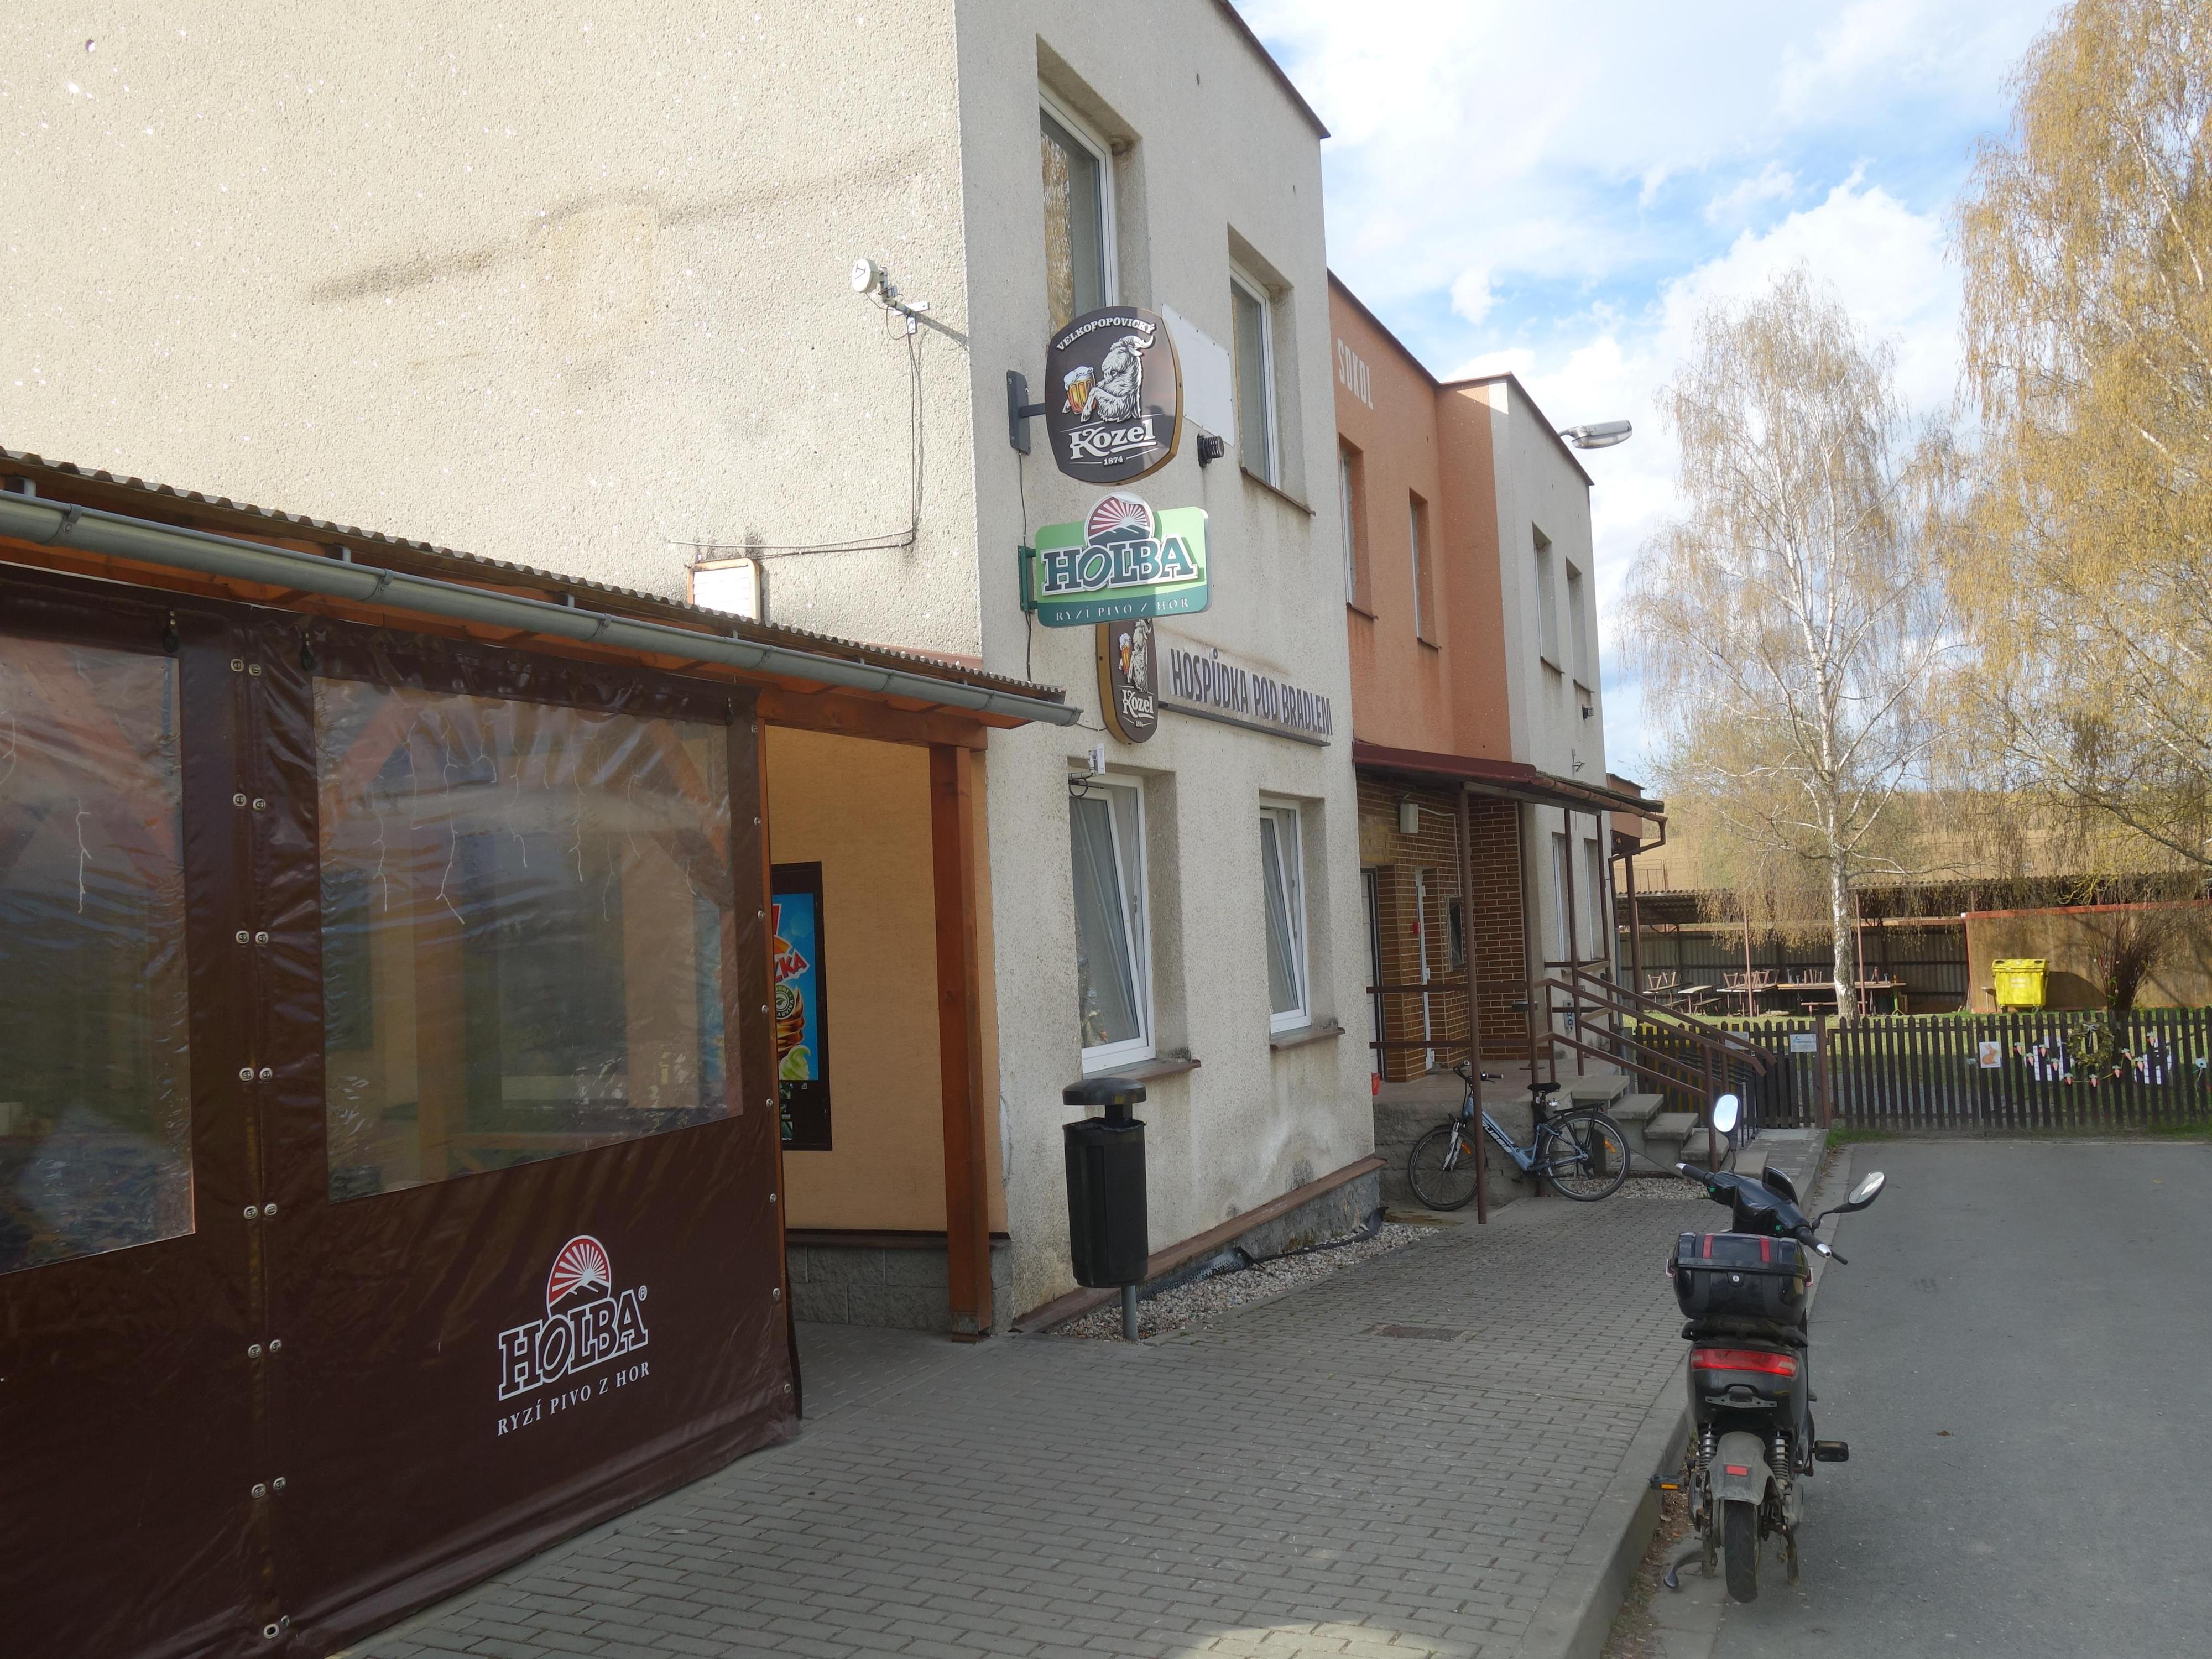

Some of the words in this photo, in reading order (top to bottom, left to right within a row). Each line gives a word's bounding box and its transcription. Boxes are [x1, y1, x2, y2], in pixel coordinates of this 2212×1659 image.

[1056, 317, 1156, 351] VELKOPOPOVICKÝ
[1337, 338, 1374, 410] SOKOL
[1068, 419, 1158, 460] Kozel
[1104, 456, 1124, 465] 1874
[1040, 534, 1198, 595] HOLBA
[1056, 606, 1090, 621] RYZÍ
[1098, 604, 1132, 617] PIVO
[1157, 598, 1189, 611] HOR
[1122, 689, 1154, 718] Kozel
[1170, 647, 1249, 714] HOSPŮDKA
[1252, 674, 1279, 719] POD
[1281, 684, 1333, 735] BRADLEM
[498, 1289, 648, 1401] HOLBA
[497, 1399, 541, 1436] RYZÍ
[550, 1385, 591, 1414] PIVO
[599, 1377, 608, 1395] Z
[615, 1361, 649, 1387] HOR
